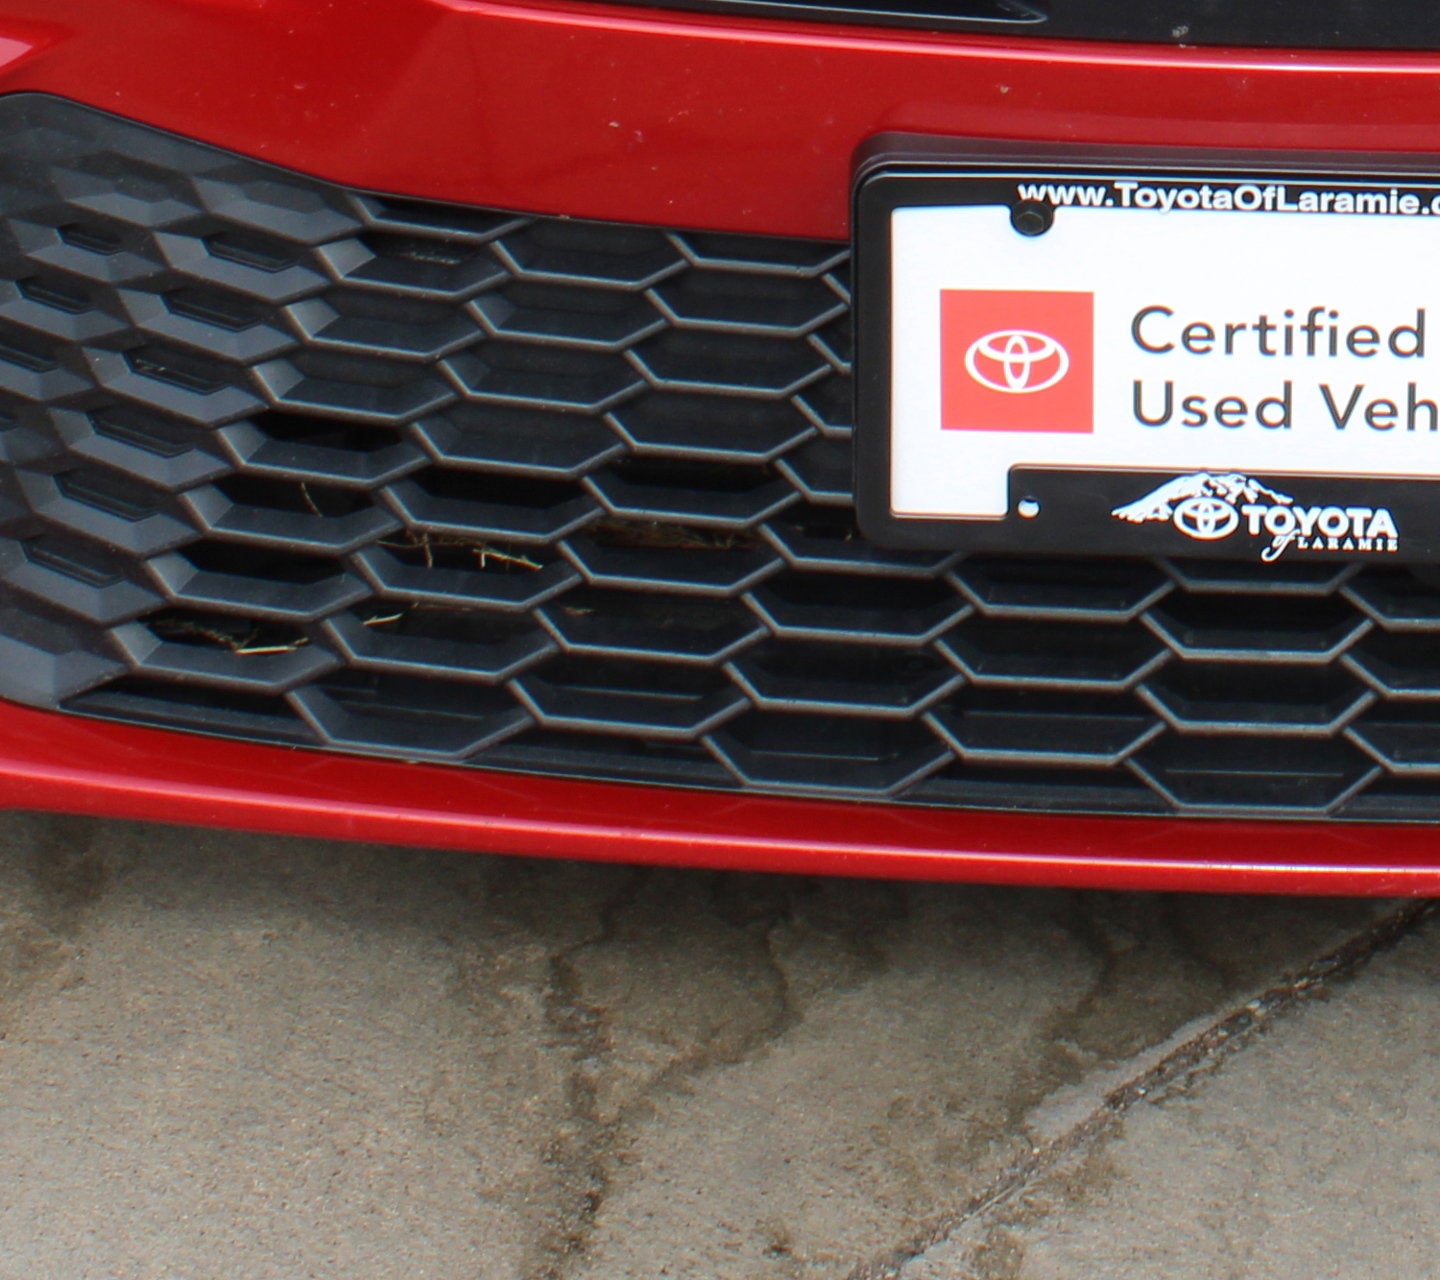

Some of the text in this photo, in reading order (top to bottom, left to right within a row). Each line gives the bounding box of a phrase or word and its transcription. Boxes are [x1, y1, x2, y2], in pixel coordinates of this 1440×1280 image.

[1130, 304, 1426, 359] Certified
[1132, 380, 1293, 430] Used
[1241, 504, 1399, 538] TOYOTA
[1261, 528, 1399, 562] of LARAMIE
